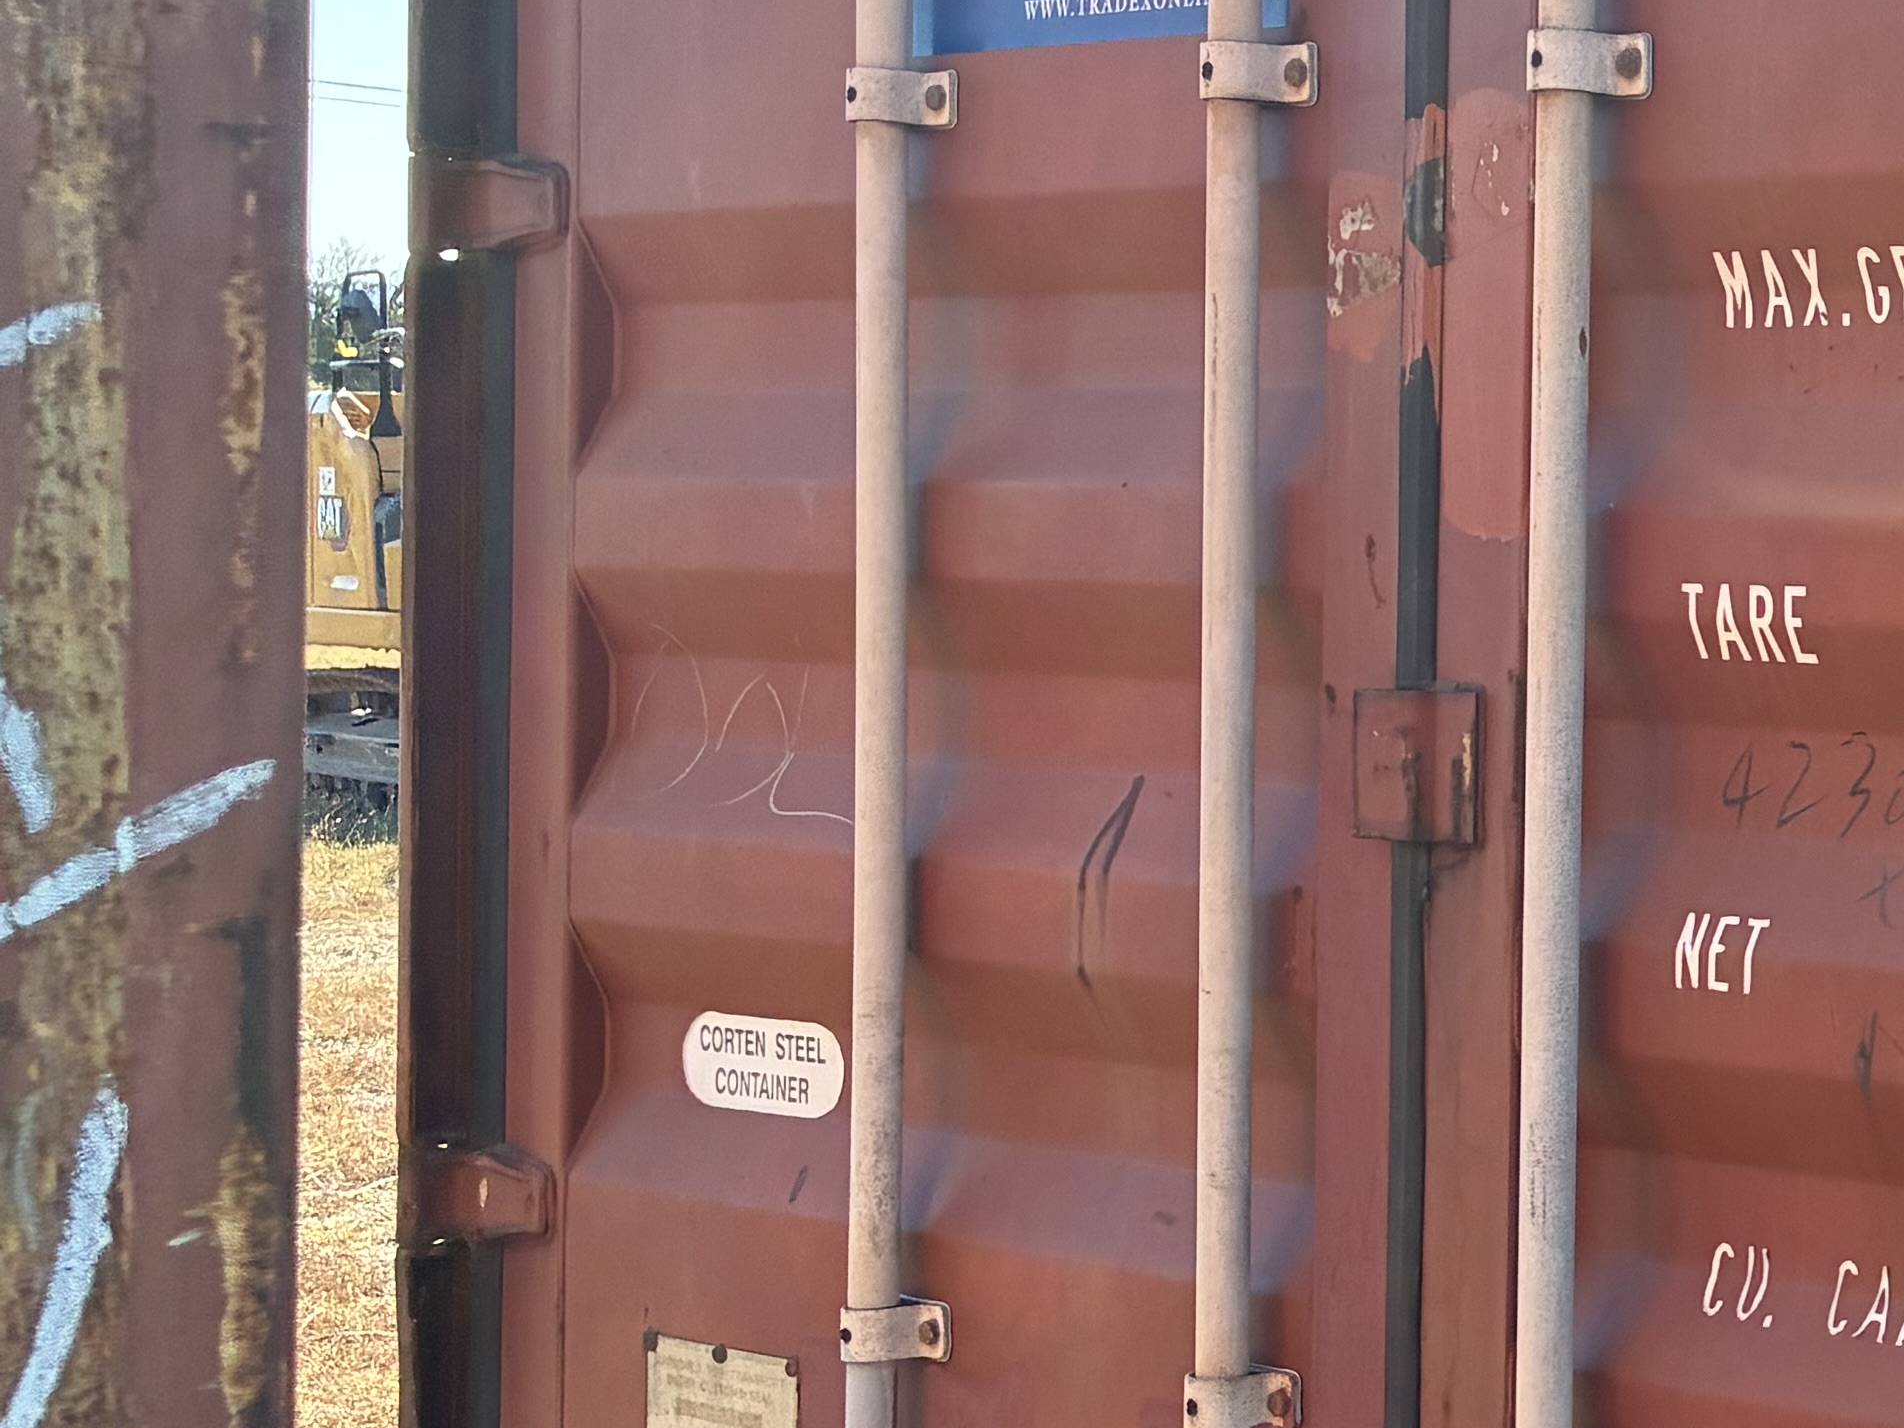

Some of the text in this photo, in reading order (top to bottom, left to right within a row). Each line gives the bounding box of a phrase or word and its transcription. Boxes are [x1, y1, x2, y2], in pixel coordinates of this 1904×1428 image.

[317, 498, 343, 540] CAT
[1681, 582, 1819, 665] TARE
[1675, 912, 1772, 995] NET
[700, 1024, 827, 1065] CORTEN STEEL
[715, 1067, 810, 1105] CONTAINER
[1702, 1242, 1775, 1329] CU.
